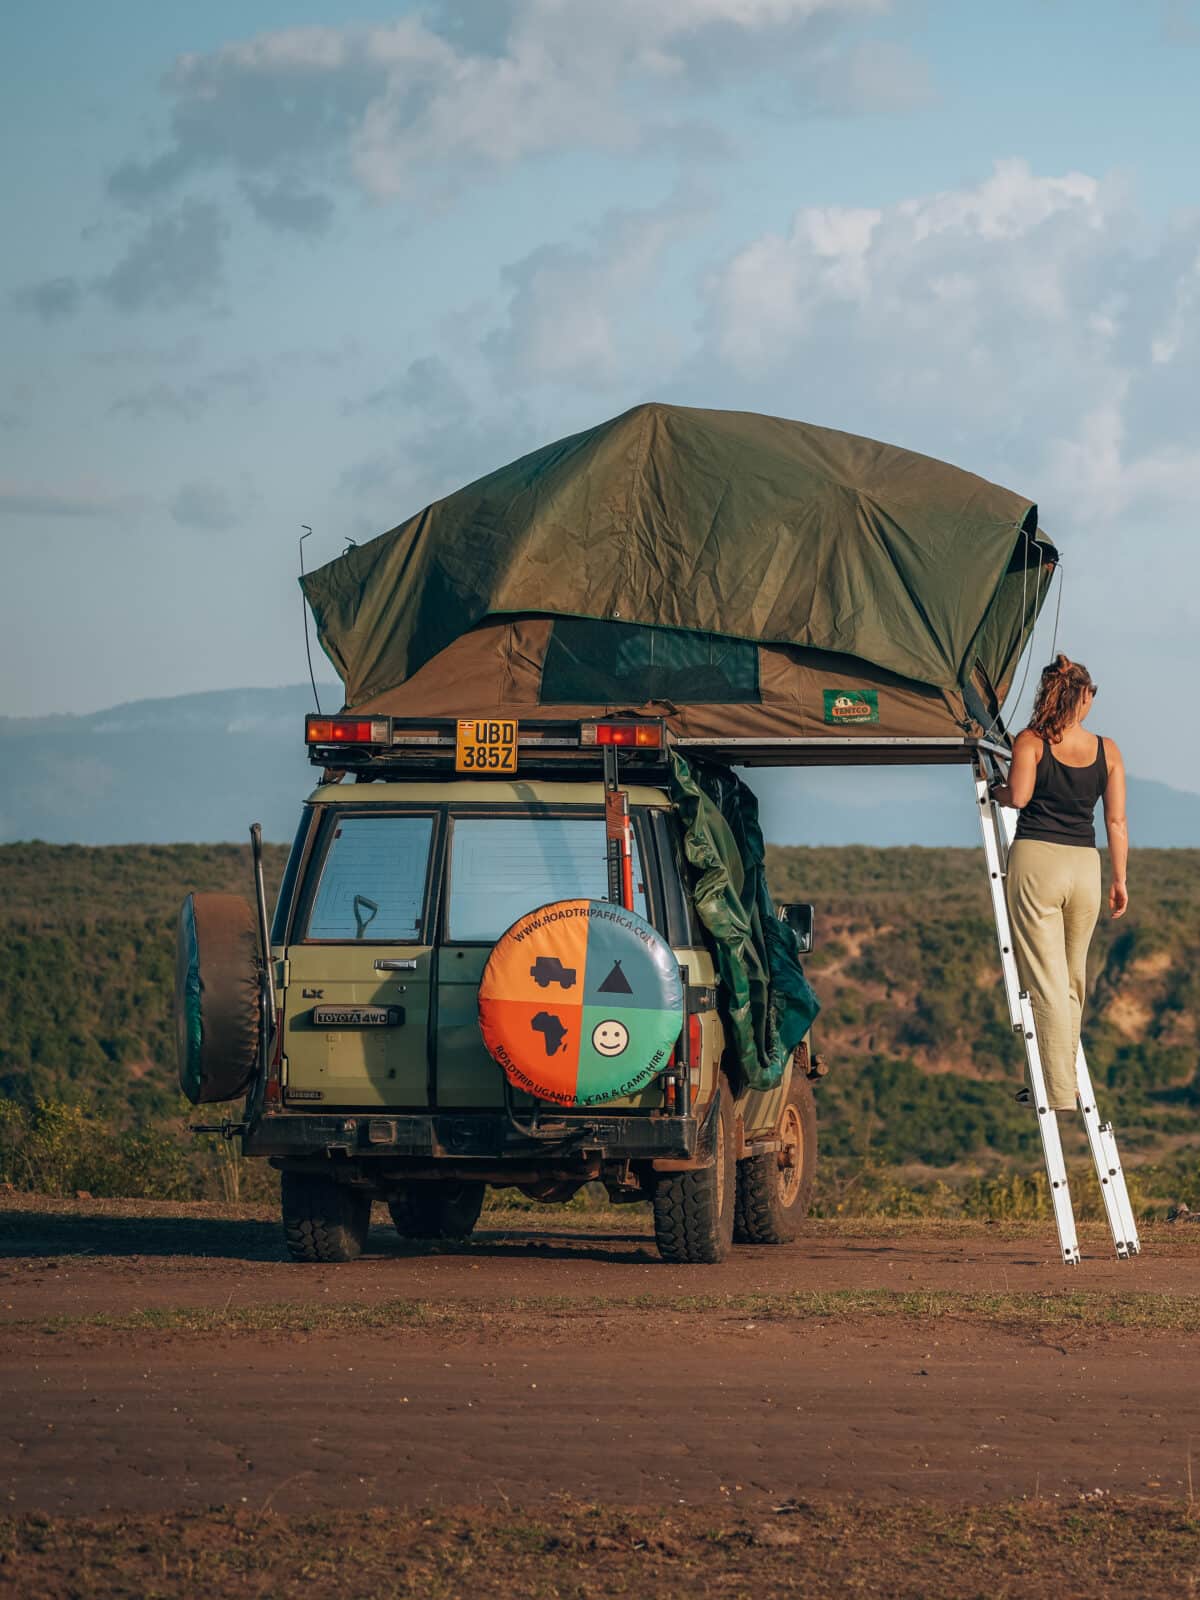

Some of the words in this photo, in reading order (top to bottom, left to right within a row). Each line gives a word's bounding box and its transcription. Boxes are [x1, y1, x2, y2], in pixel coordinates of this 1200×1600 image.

[475, 722, 514, 744] UBD
[463, 746, 513, 768] 385Z
[302, 989, 324, 999] LX
[320, 1013, 359, 1022] TOYOTA
[361, 1013, 387, 1023] 4WD
[496, 1045, 534, 1086] ROADTRIP
[534, 1085, 578, 1104] UGANDA
[587, 1092, 609, 1105] CAR
[620, 1070, 649, 1095] CAMP
[646, 1049, 664, 1072] HIRE
